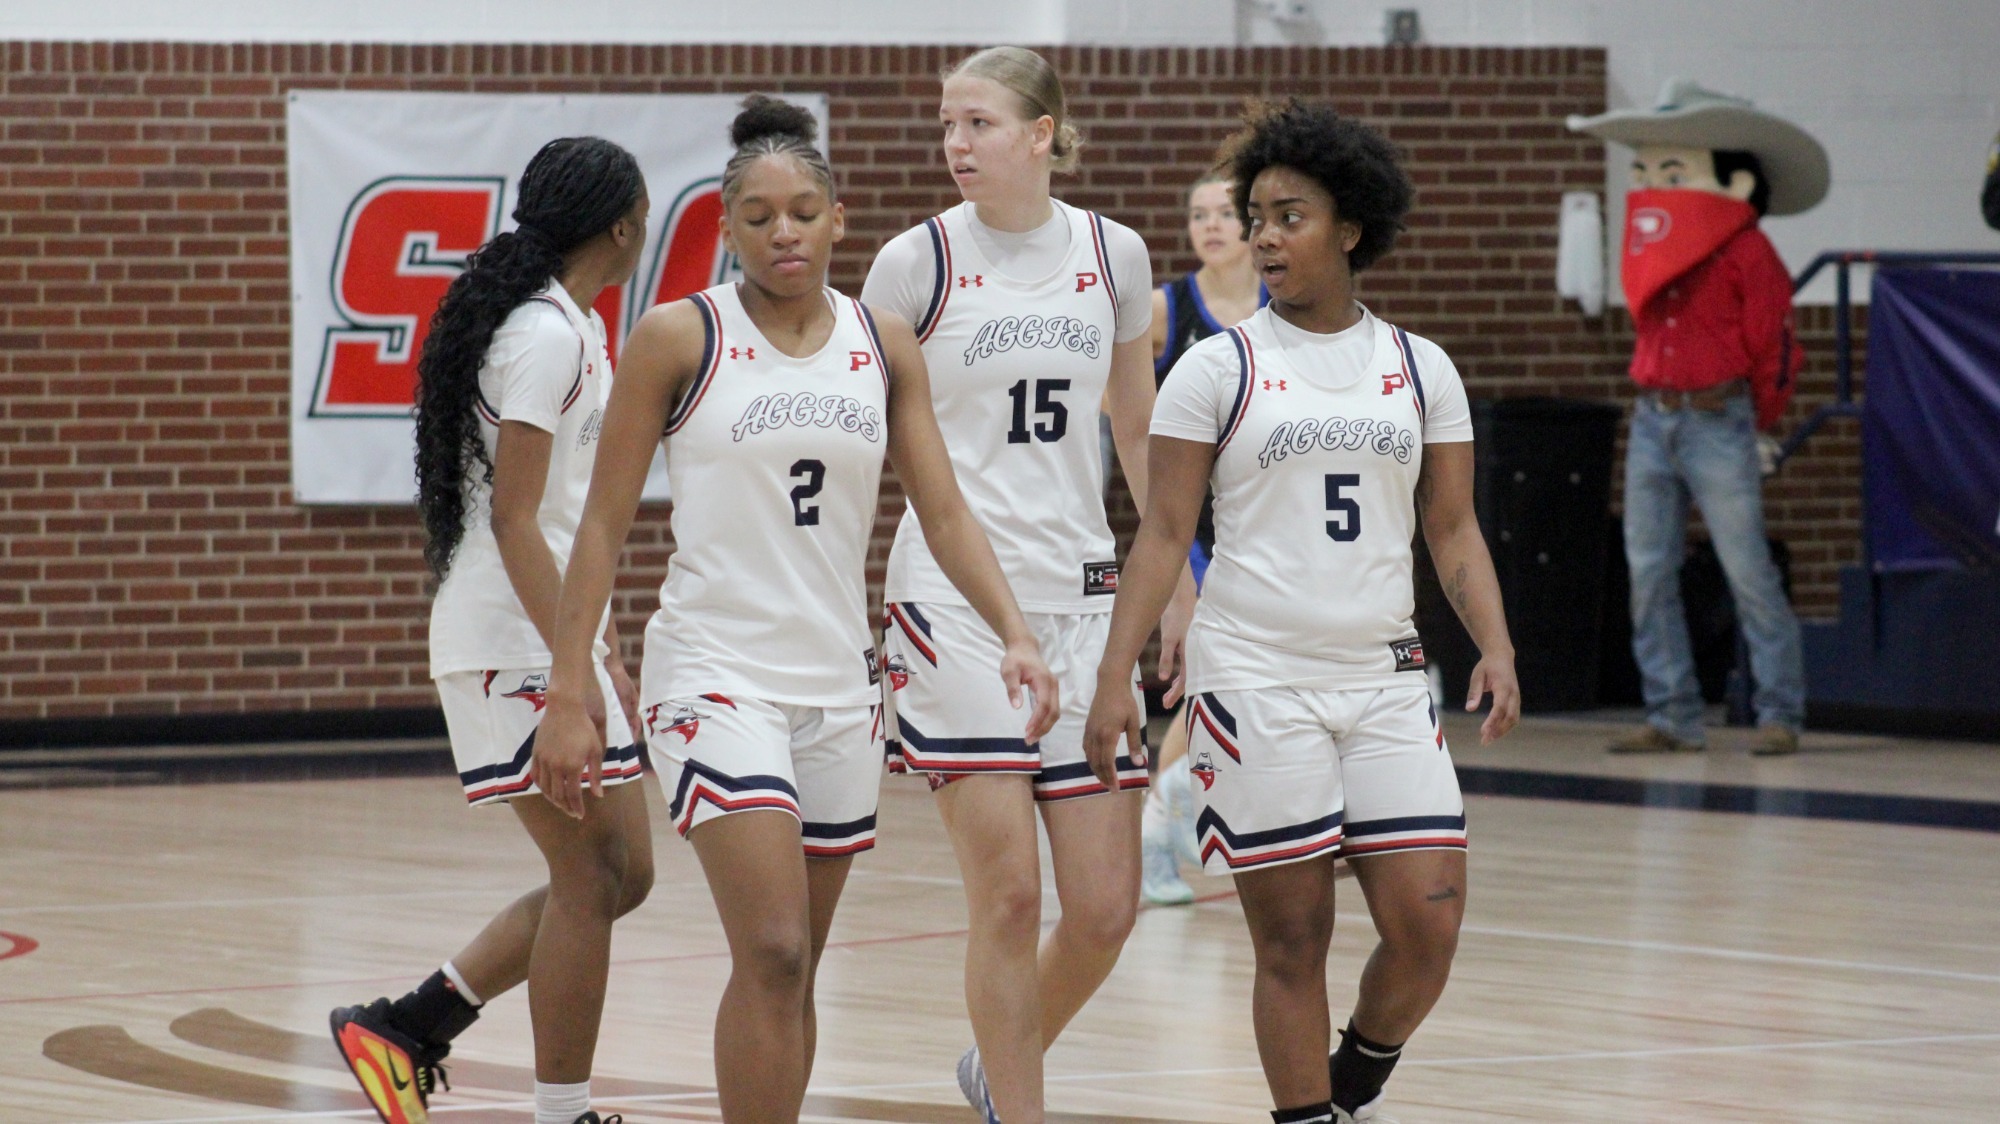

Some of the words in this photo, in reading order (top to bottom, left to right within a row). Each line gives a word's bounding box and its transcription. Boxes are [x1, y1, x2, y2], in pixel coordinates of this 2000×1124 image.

[1629, 206, 1673, 256] P
[1076, 272, 1098, 292] P
[850, 351, 872, 371] P
[966, 315, 1100, 366] AGGIES
[1381, 373, 1406, 395] P
[732, 392, 880, 442] AGGIES
[1008, 379, 1071, 444] 15
[1259, 417, 1414, 468] AGGIES
[790, 460, 827, 526] 2
[1324, 474, 1361, 542] 5
